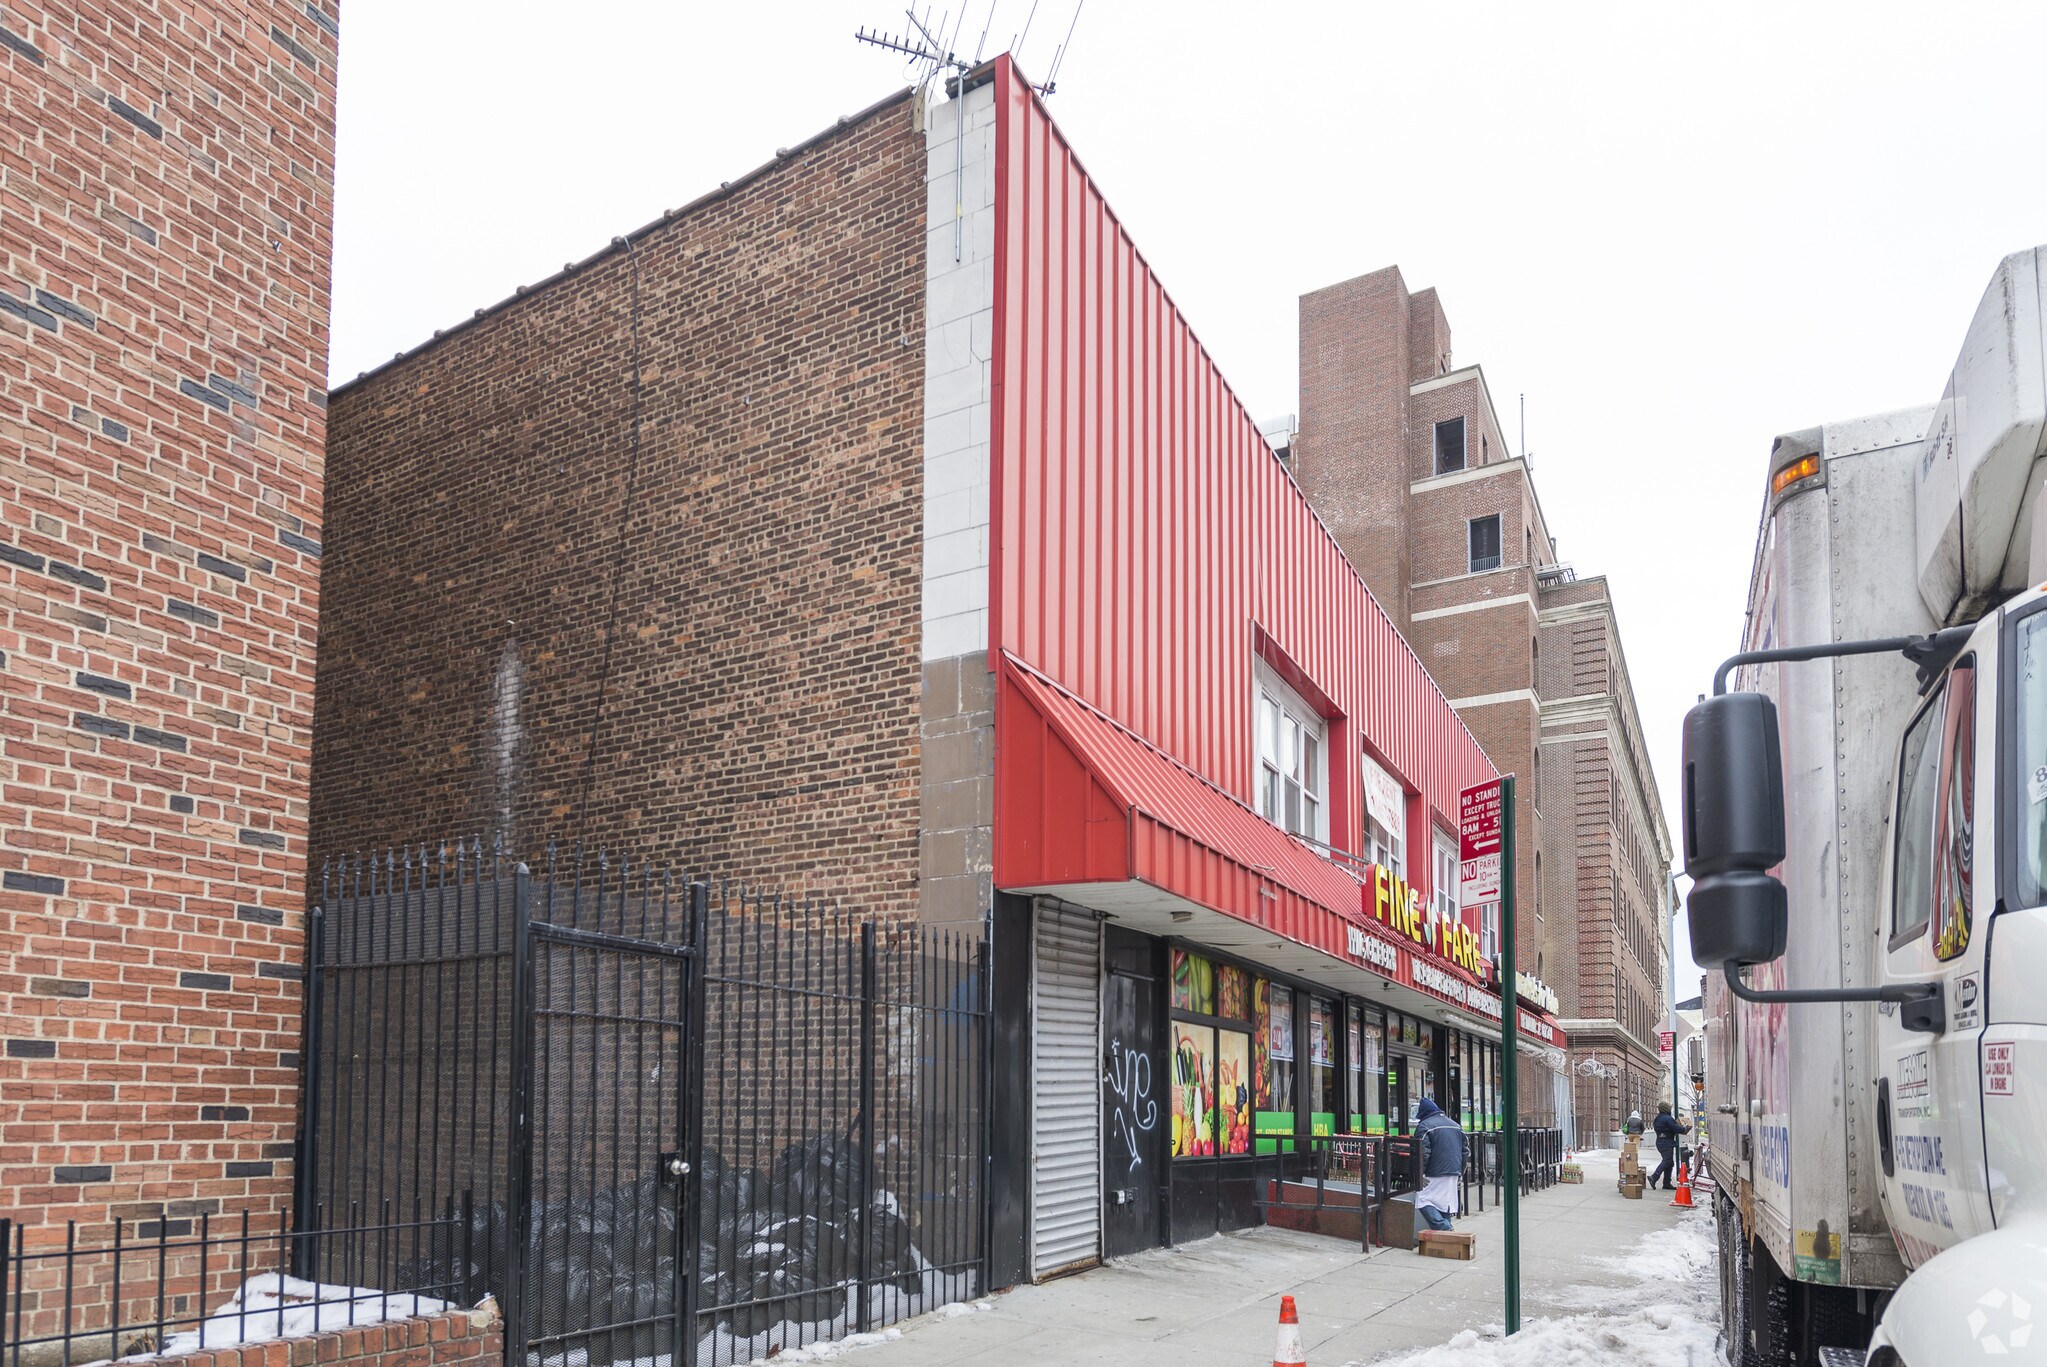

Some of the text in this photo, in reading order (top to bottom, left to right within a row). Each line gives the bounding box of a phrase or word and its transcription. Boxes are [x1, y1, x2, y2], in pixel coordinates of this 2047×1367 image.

[2035, 766, 2047, 783] 8
[1462, 786, 1500, 807] NO STANDI
[1464, 799, 1501, 816] EXCEPT TRUC
[1461, 814, 1479, 825] LOADING
[1486, 809, 1501, 818] UNLOA
[1462, 822, 1479, 835] 8AM
[1468, 828, 1501, 841] EXCEPT SUNDA
[1462, 857, 1500, 880] NO PARKI
[1468, 881, 1488, 890] INCLUDING
[1374, 863, 1482, 977] FINE FARE
[1988, 1047, 2009, 1060] USE ONLY
[1994, 1077, 2007, 1091] ENGINE
